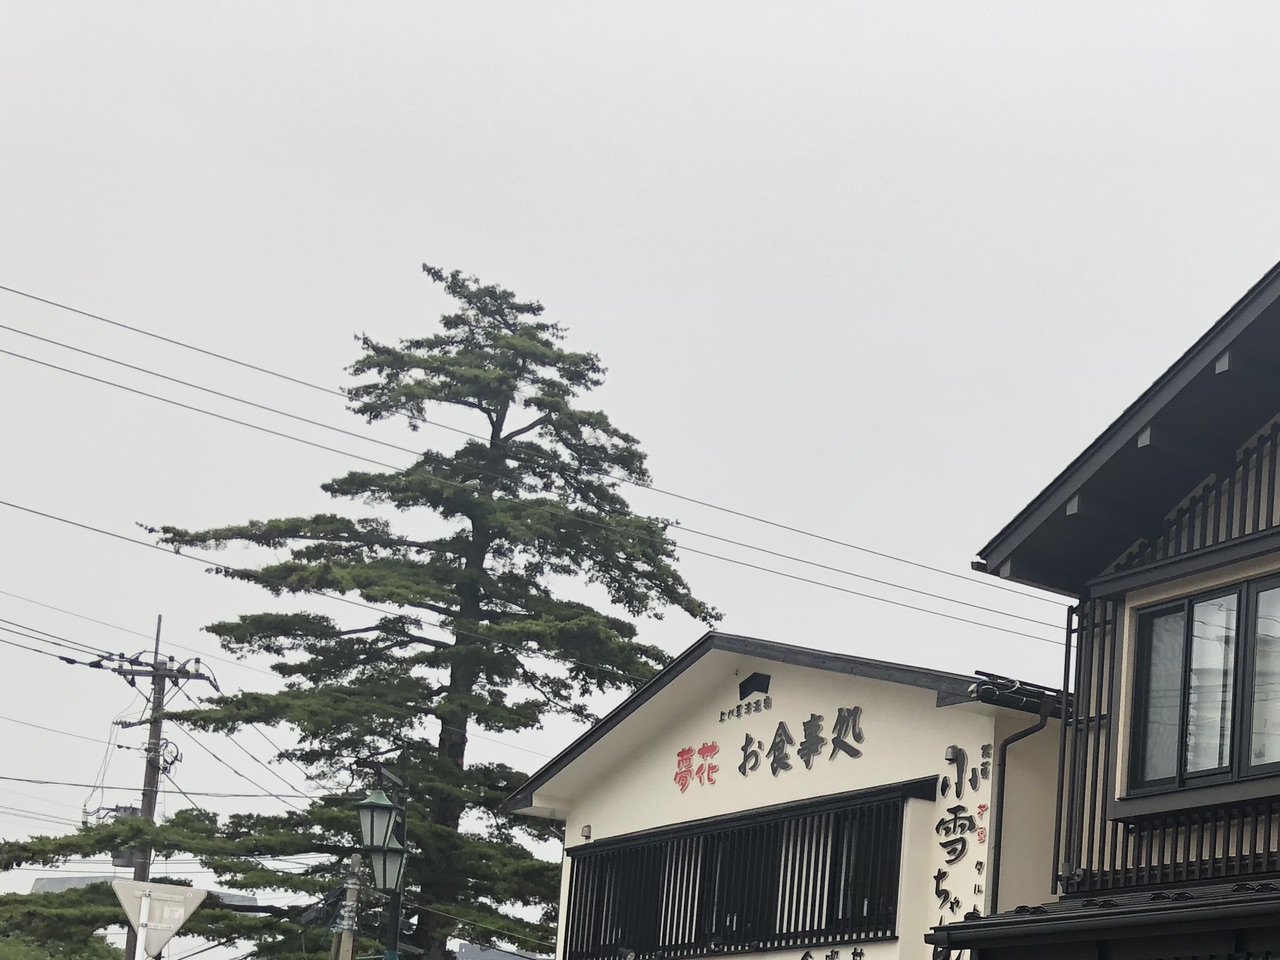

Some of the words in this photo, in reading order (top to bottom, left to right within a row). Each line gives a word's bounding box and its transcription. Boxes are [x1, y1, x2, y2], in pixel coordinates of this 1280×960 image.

[673, 741, 720, 793] 夢花
[738, 705, 865, 778] お食事処
